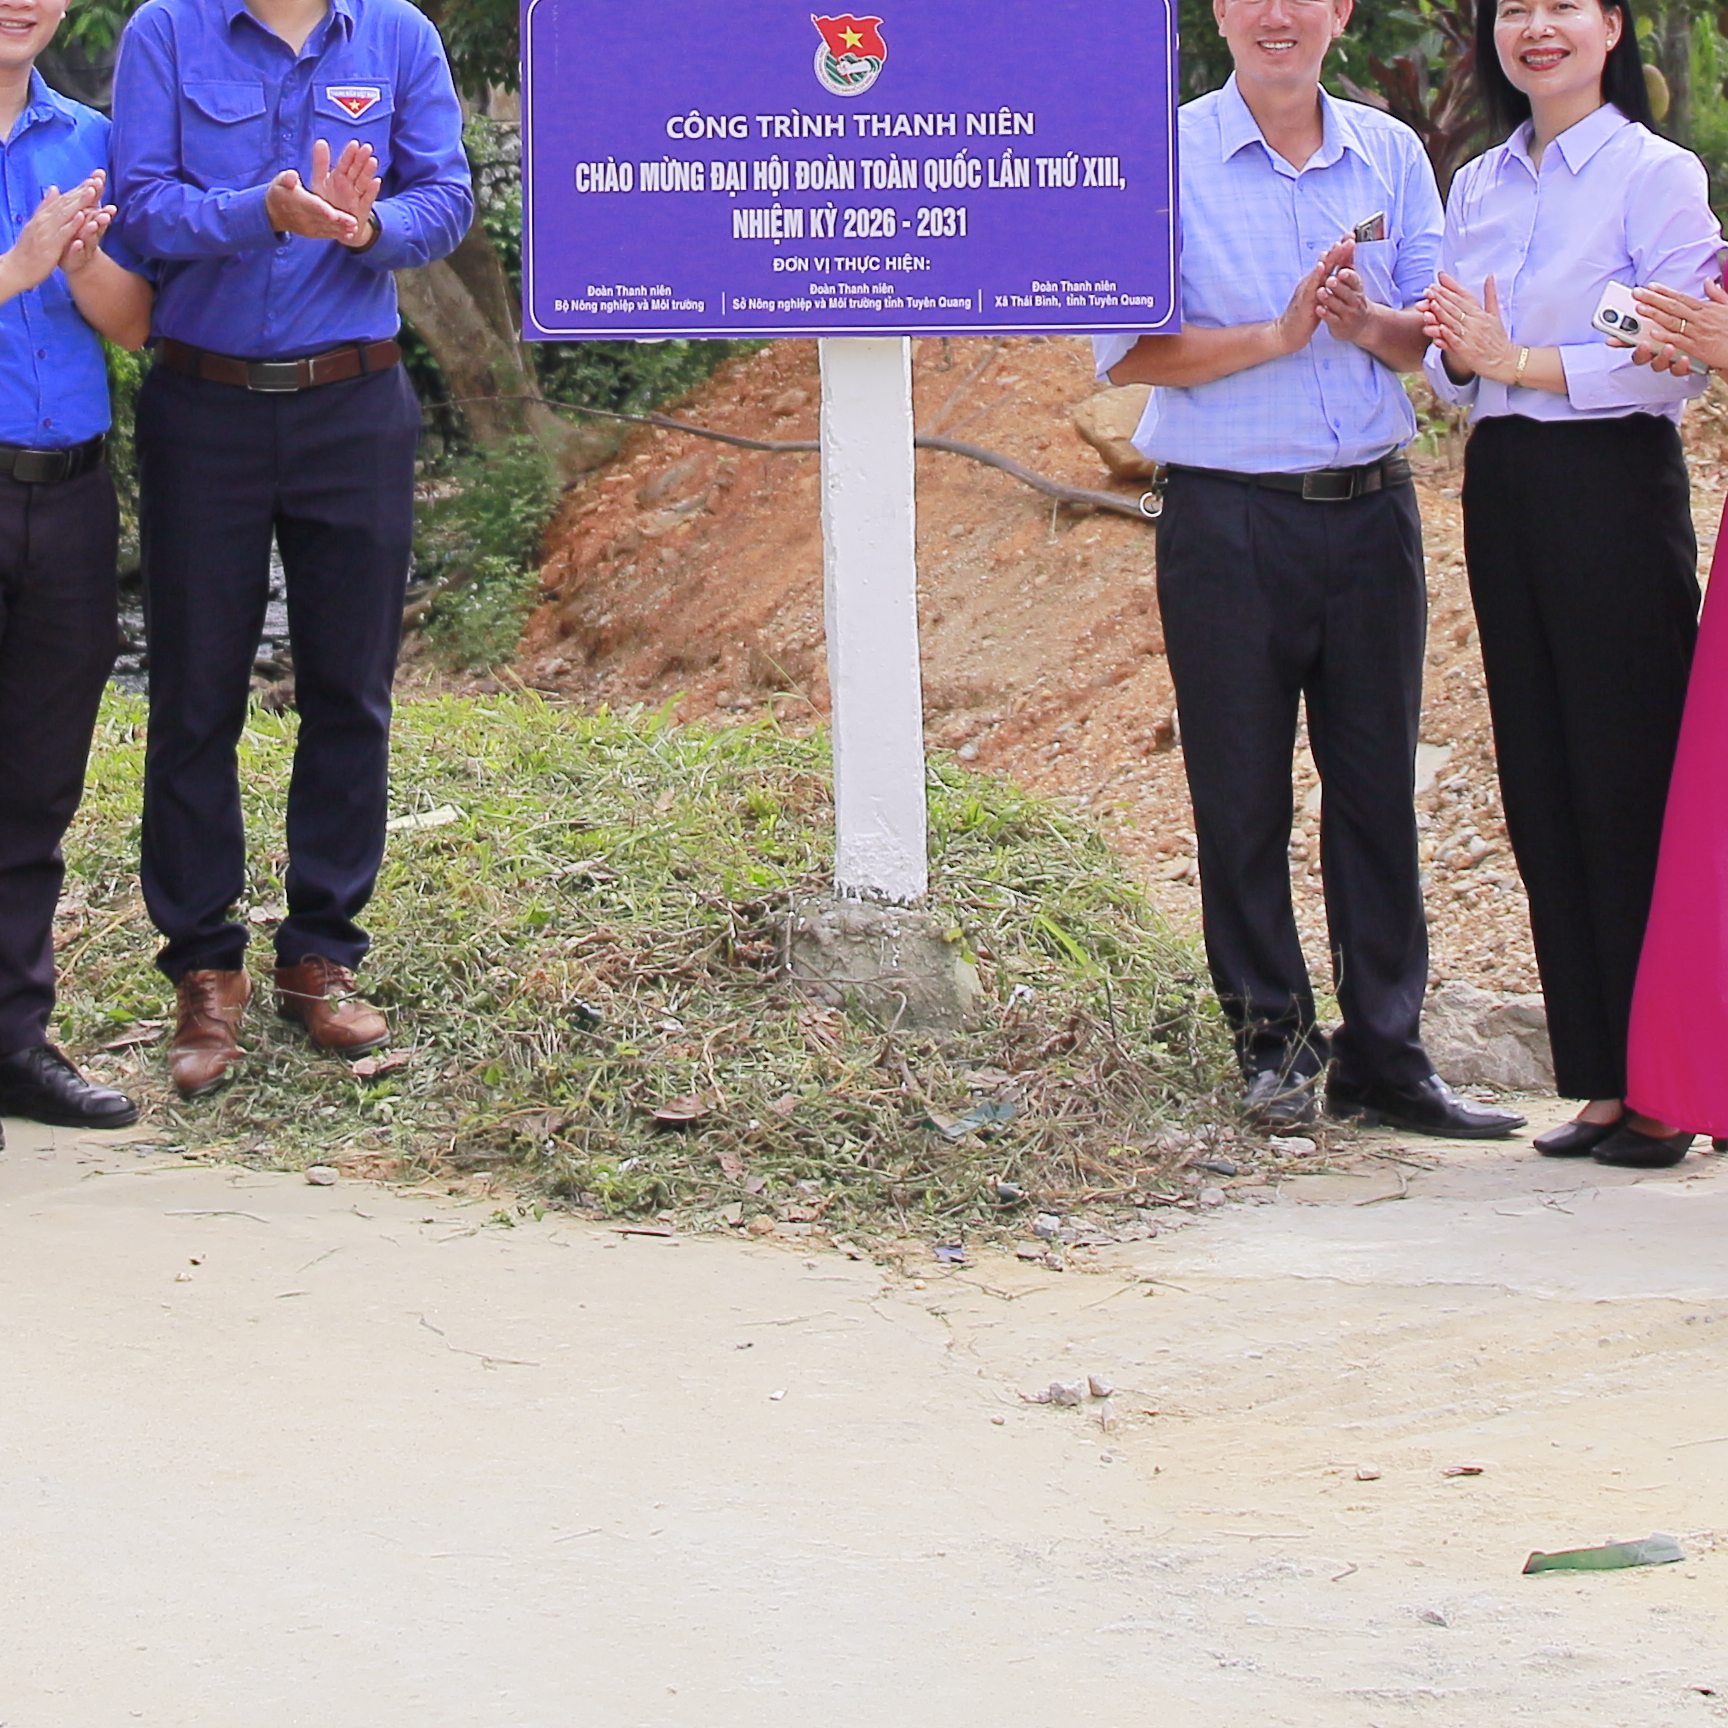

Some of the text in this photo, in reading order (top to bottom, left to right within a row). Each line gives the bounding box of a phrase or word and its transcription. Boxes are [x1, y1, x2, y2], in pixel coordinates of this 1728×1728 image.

[666, 106, 1034, 139] CÔNG TRÌNH THANH NIÊN
[575, 147, 1126, 198] CHÀO MỪNG ĐẠI HỘI ĐOÀN TOÀN QUỐC LẦN THỨ XIII,
[732, 201, 967, 245] NHIỆM KỲ 2026 - 2031
[773, 253, 930, 274] ĐƠN VỊ THỰC HIỆN:
